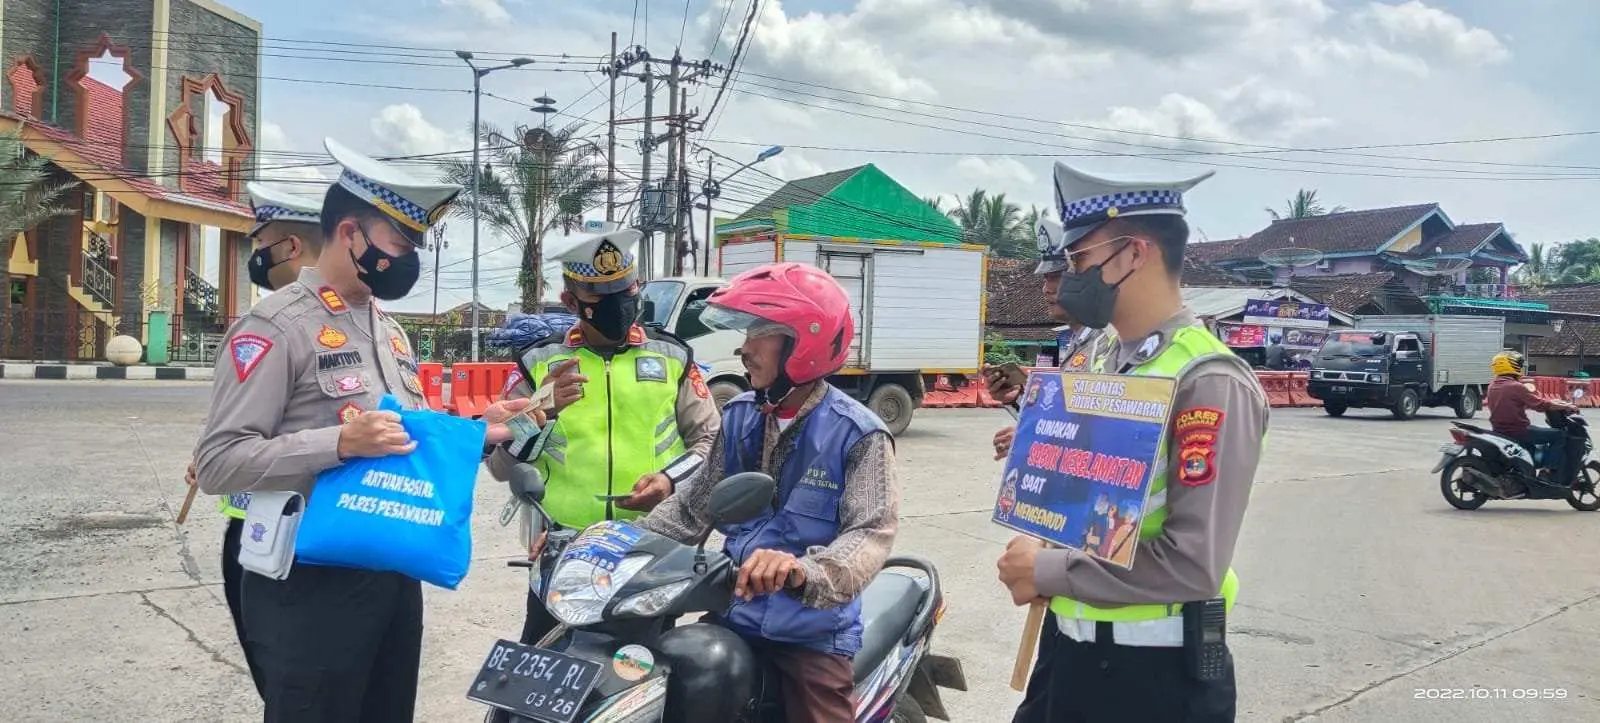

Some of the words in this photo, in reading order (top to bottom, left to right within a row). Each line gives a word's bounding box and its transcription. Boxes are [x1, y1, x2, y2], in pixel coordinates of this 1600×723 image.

[318, 351, 362, 369] MARTOYO
[1073, 379, 1089, 393] SAT
[1091, 380, 1126, 397] LANTAS
[1071, 394, 1101, 410] POLRES
[1102, 398, 1165, 418] PESAWARAN
[1035, 418, 1080, 440] GUNAKAN
[1177, 410, 1218, 427] POLRES
[1058, 447, 1147, 491] KESELAMATAN
[1021, 473, 1047, 494] SAAT
[376, 499, 445, 526] PESAWARAN
[1013, 501, 1067, 533] MENGEMUDI
[487, 645, 515, 671] BE
[513, 652, 562, 681] 2354
[561, 663, 586, 690] RL
